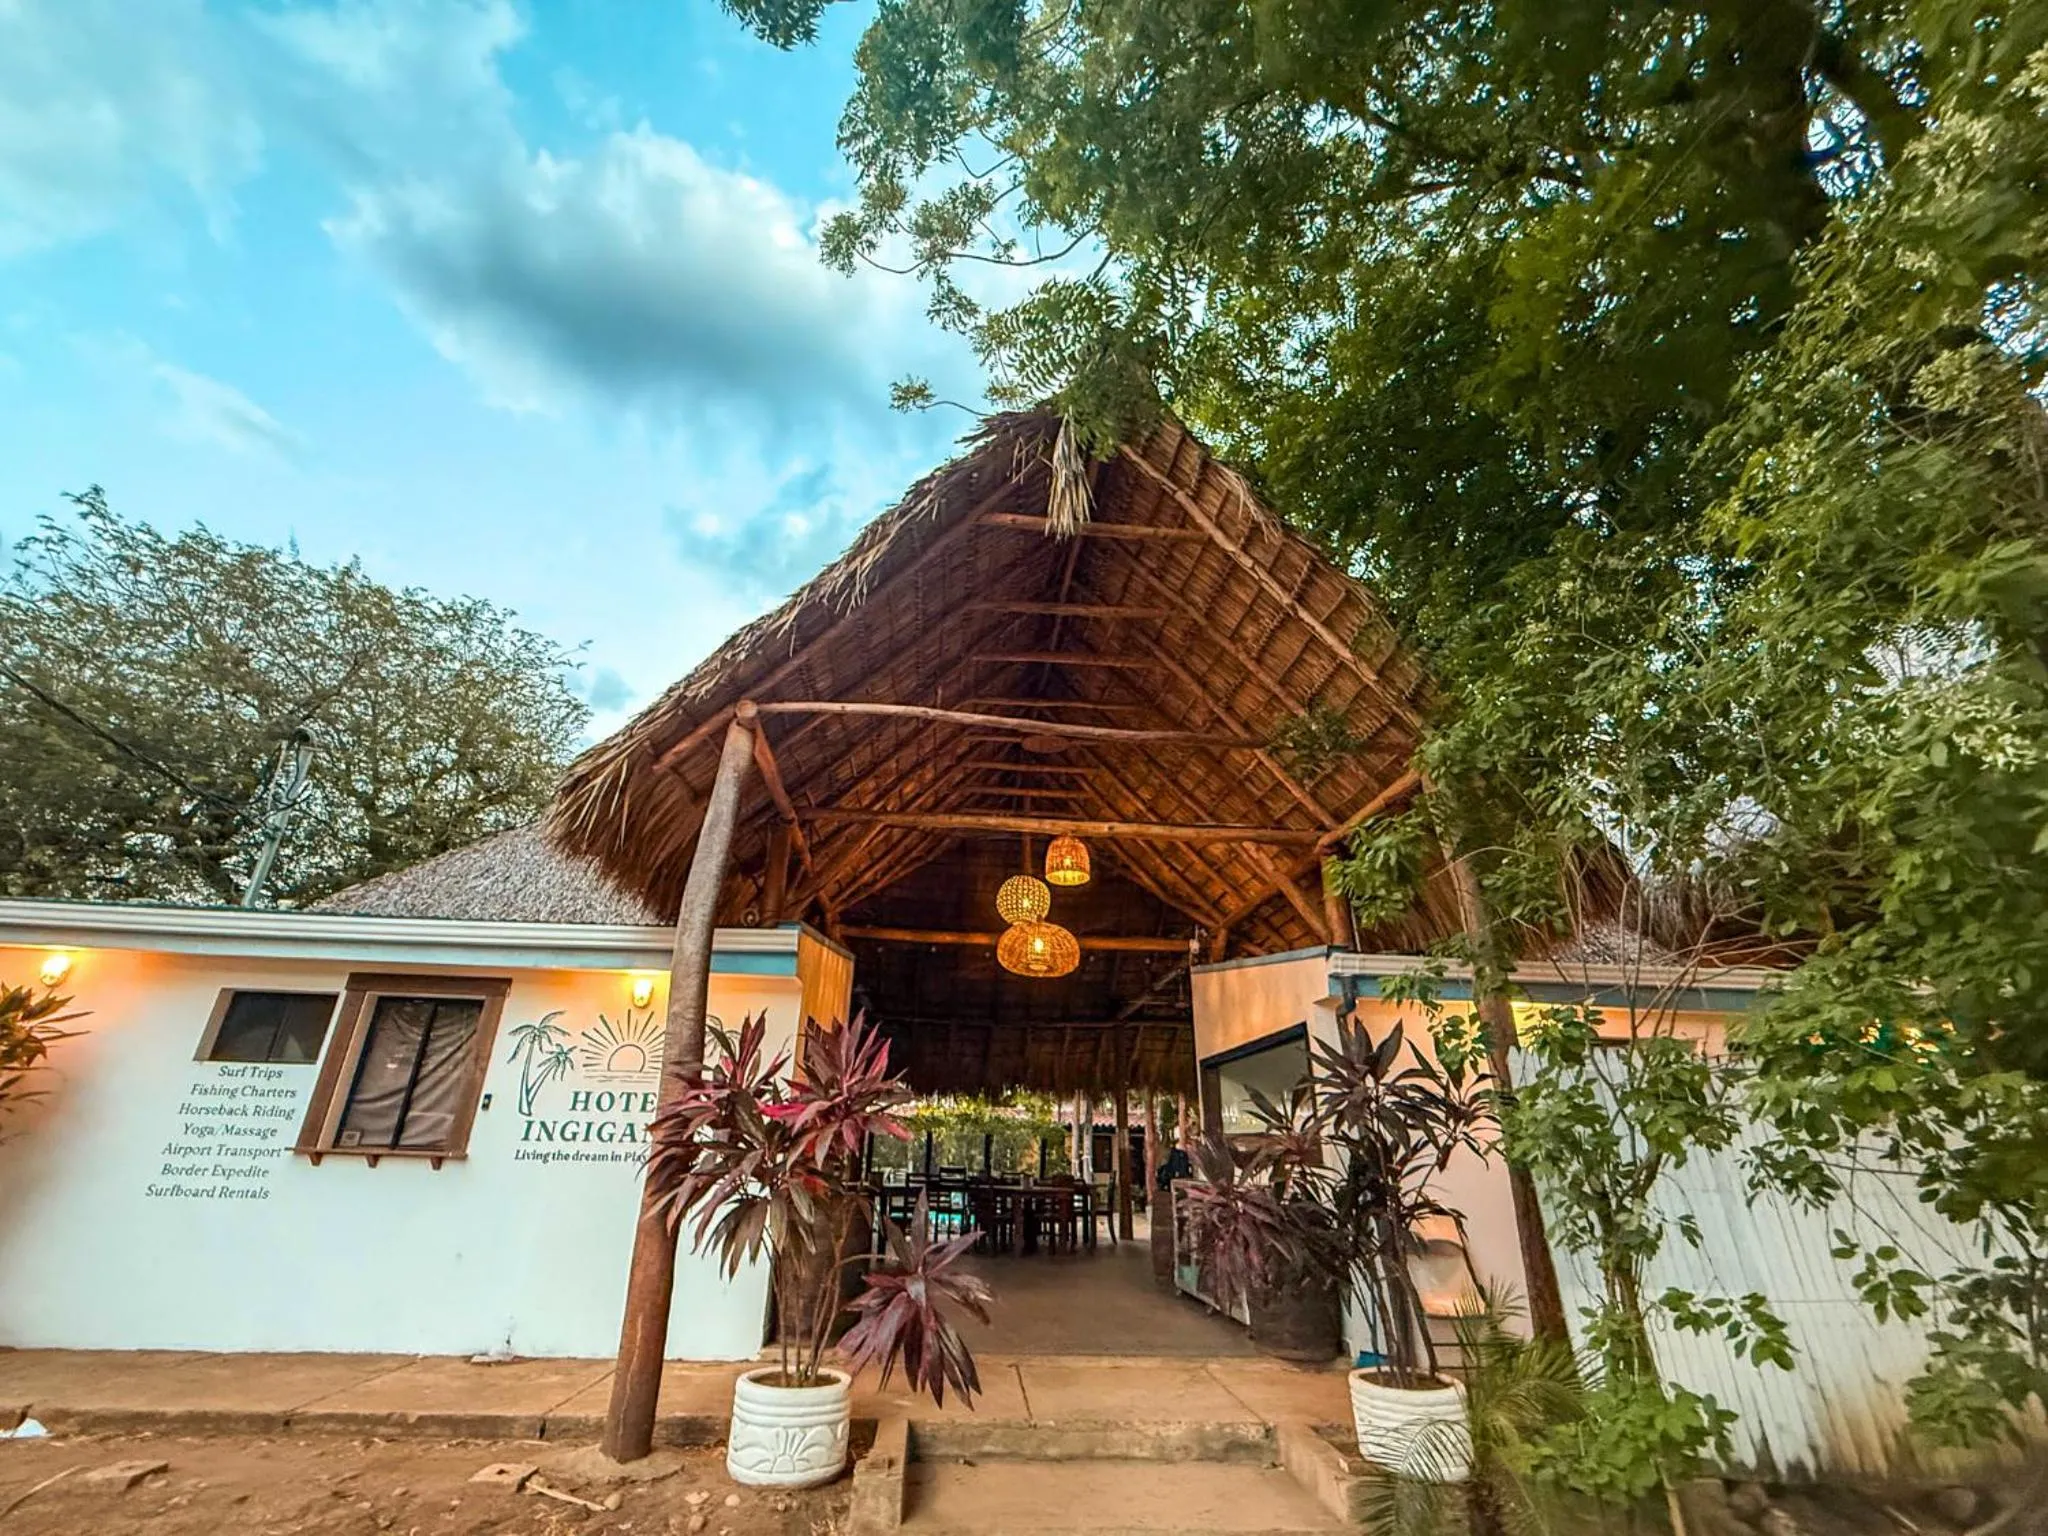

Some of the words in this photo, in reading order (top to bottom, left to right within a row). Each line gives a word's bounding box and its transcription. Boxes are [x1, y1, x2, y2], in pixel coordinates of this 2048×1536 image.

[218, 1065, 247, 1078] Surf
[249, 1066, 283, 1081] Trips
[190, 1084, 239, 1099] Fishing
[240, 1085, 297, 1098] Charters
[569, 1091, 657, 1113] HOTE
[178, 1102, 248, 1117] Horseback
[252, 1104, 295, 1120] Riding
[161, 1142, 212, 1158] Airport
[215, 1144, 282, 1160] Transport
[515, 1150, 552, 1164] Living
[552, 1150, 571, 1161] the
[572, 1151, 609, 1162] dream
[611, 1151, 622, 1162] in
[161, 1163, 208, 1176] Border
[211, 1164, 269, 1180] Expedite
[145, 1183, 216, 1198] Surfboard
[218, 1186, 270, 1200] Rentals
